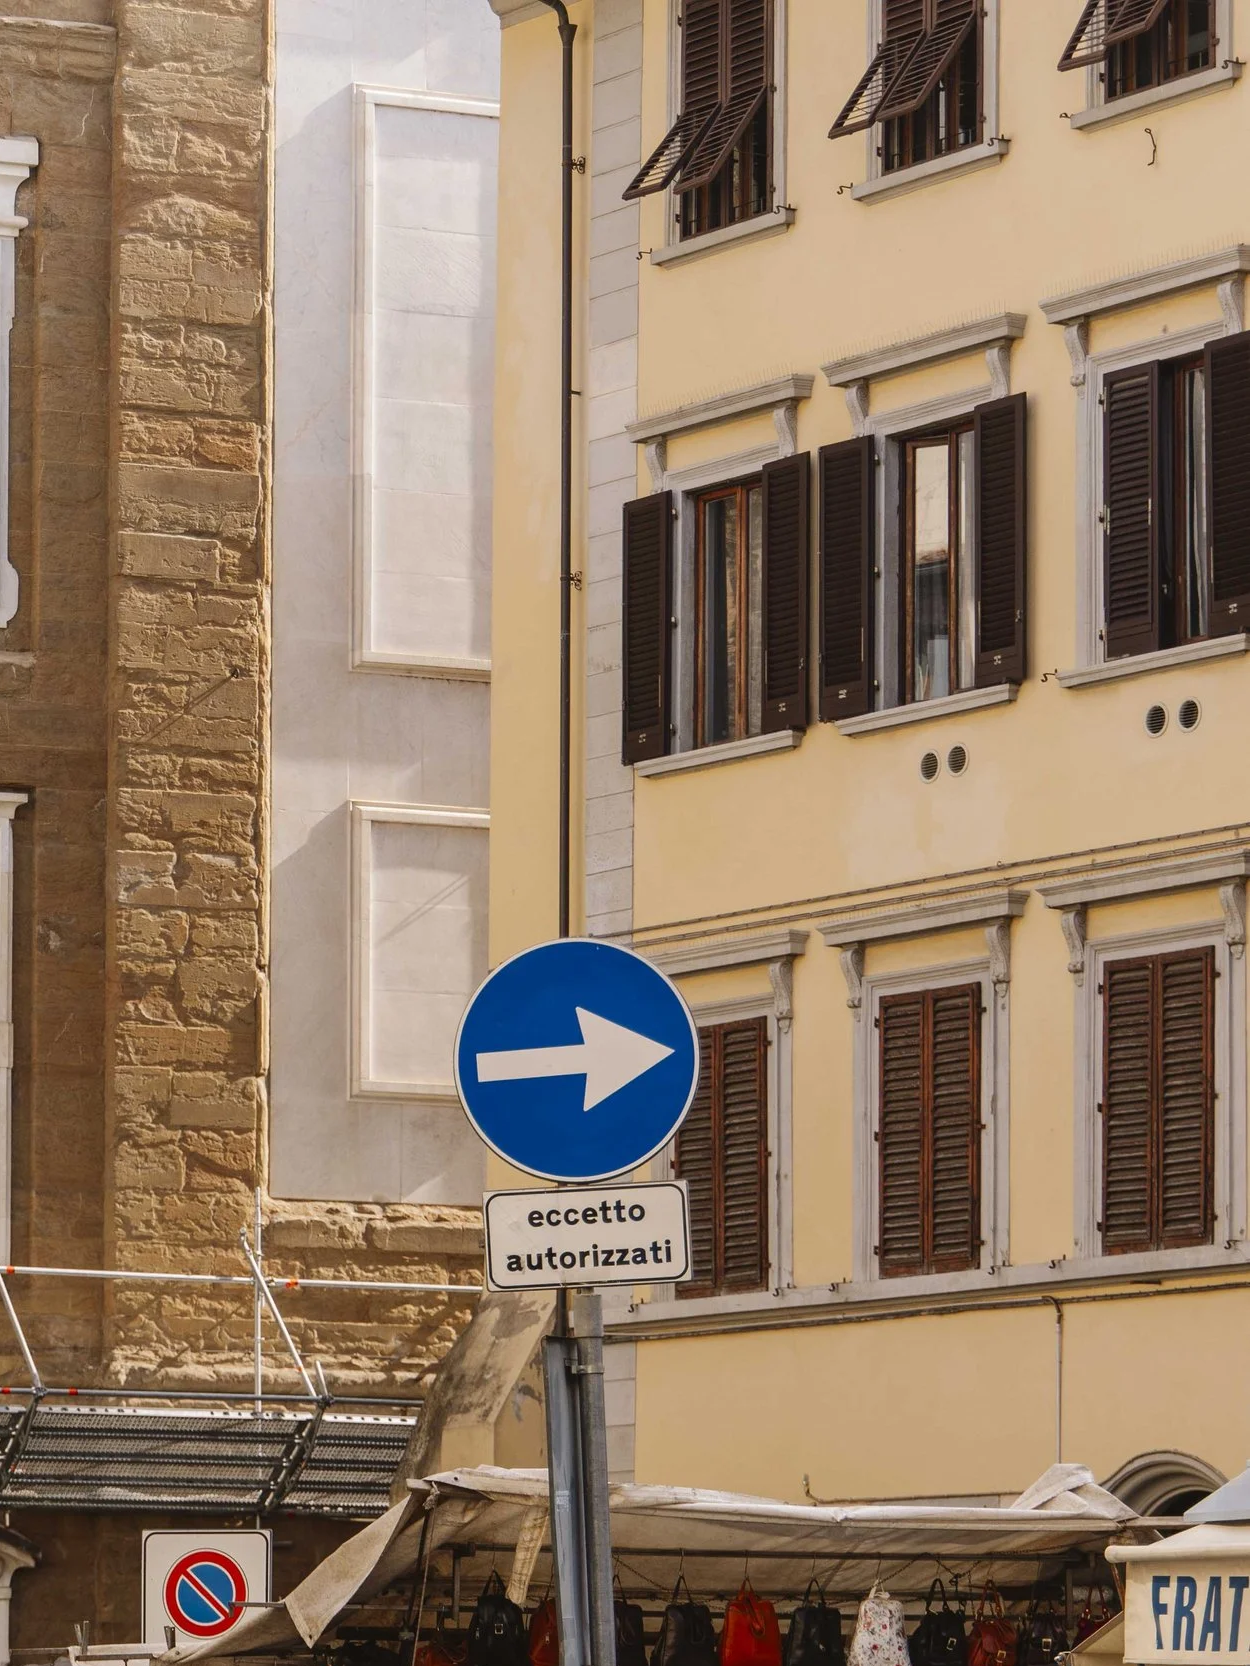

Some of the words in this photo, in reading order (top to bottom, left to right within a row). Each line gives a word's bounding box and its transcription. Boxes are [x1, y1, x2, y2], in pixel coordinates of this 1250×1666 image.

[527, 1199, 646, 1228] eccetto
[506, 1238, 672, 1272] autorizzati
[1151, 1575, 1250, 1652] FRAT
